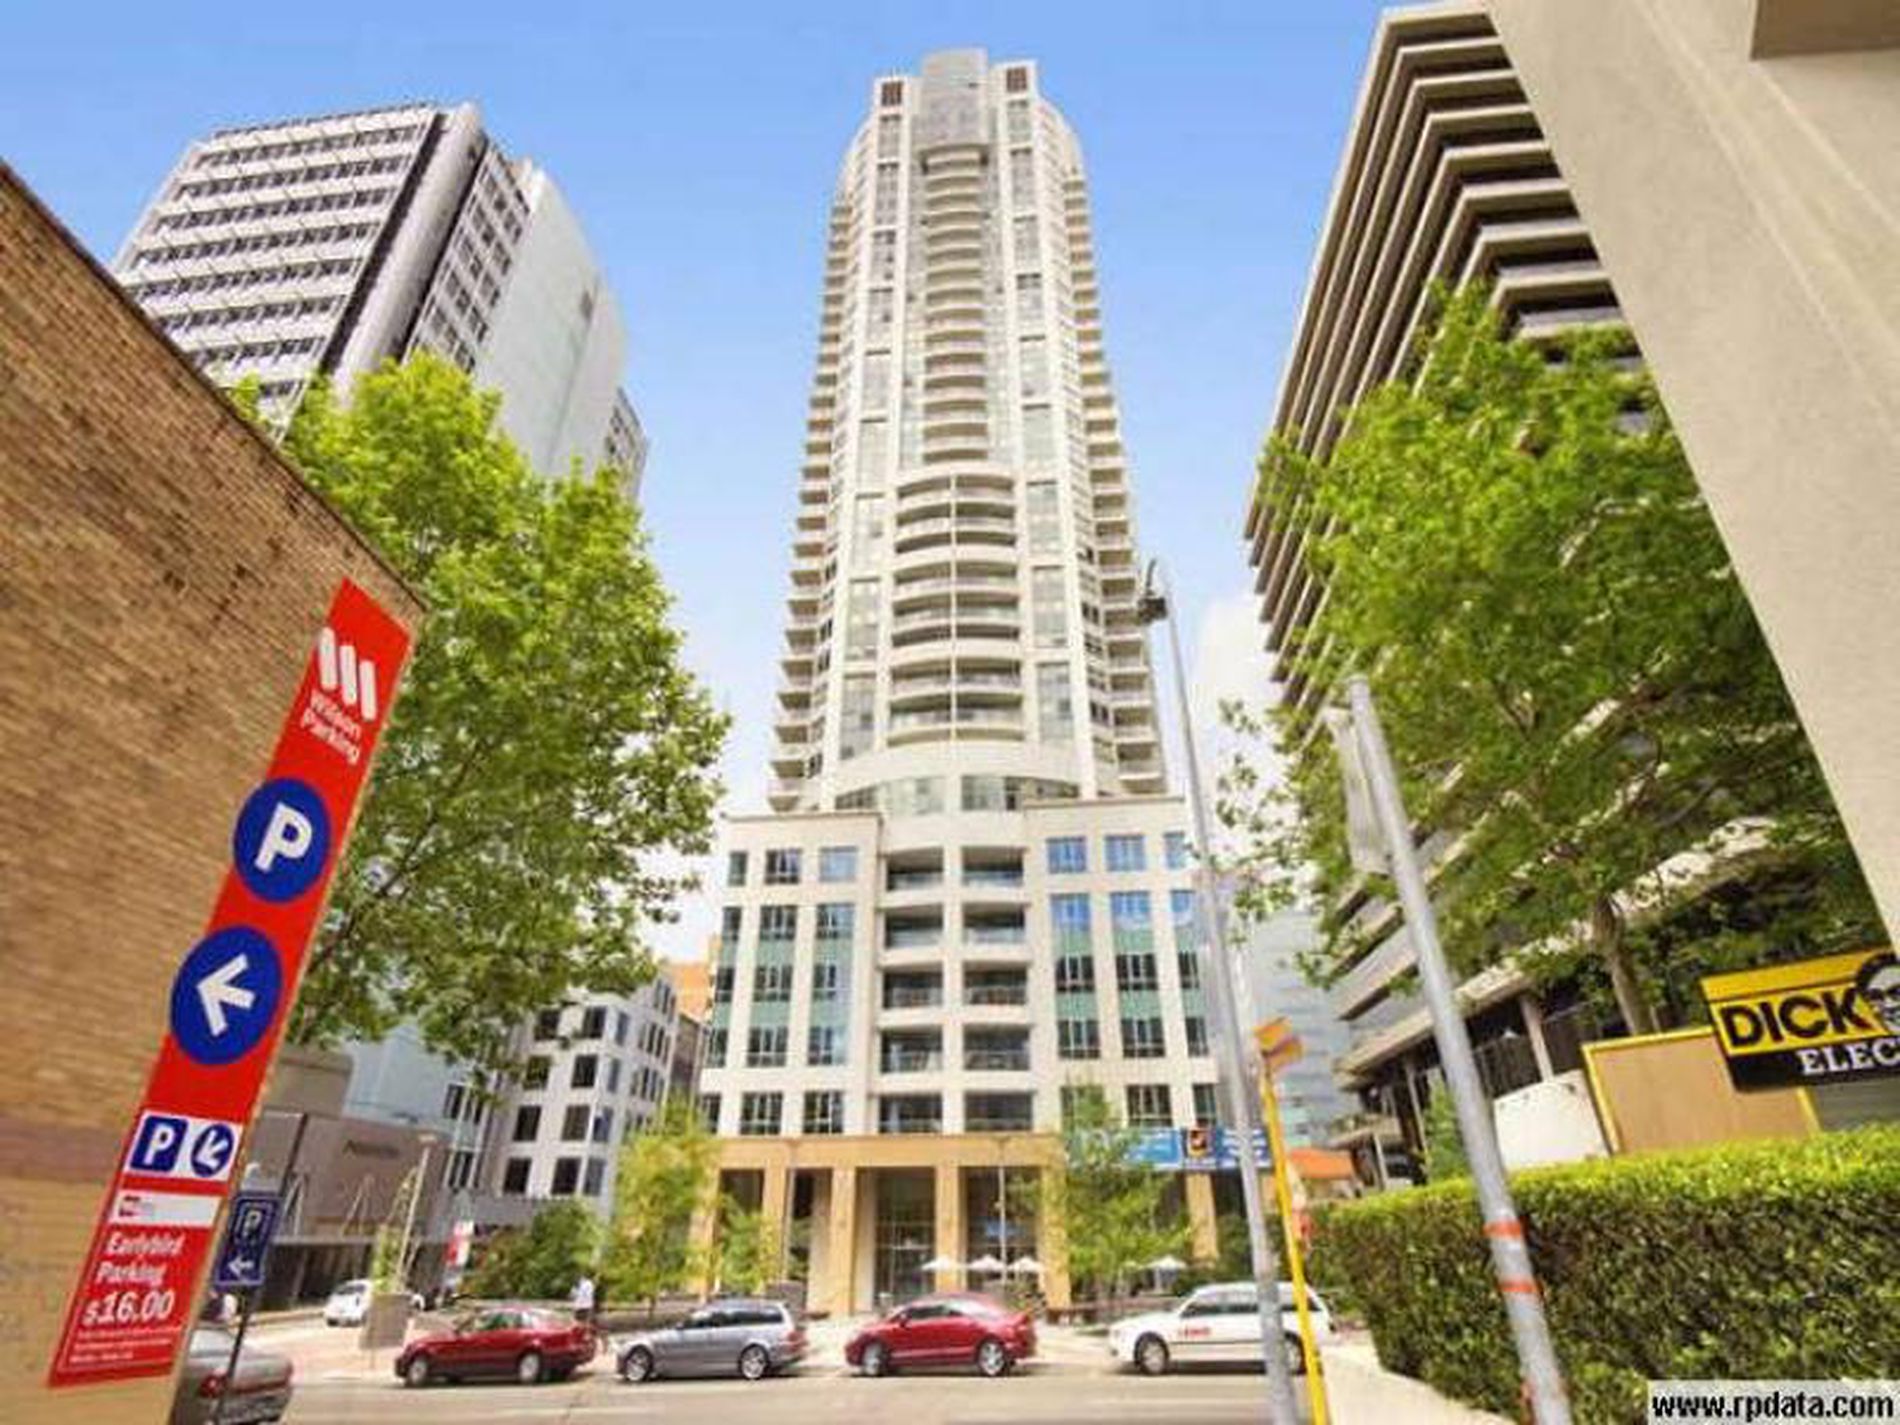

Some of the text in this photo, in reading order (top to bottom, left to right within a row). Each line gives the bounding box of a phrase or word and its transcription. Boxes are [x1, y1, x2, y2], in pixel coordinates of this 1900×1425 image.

[254, 801, 313, 873] P
[1719, 986, 1875, 1048] DICK
[143, 1122, 175, 1166] P
[242, 1209, 263, 1238] P
